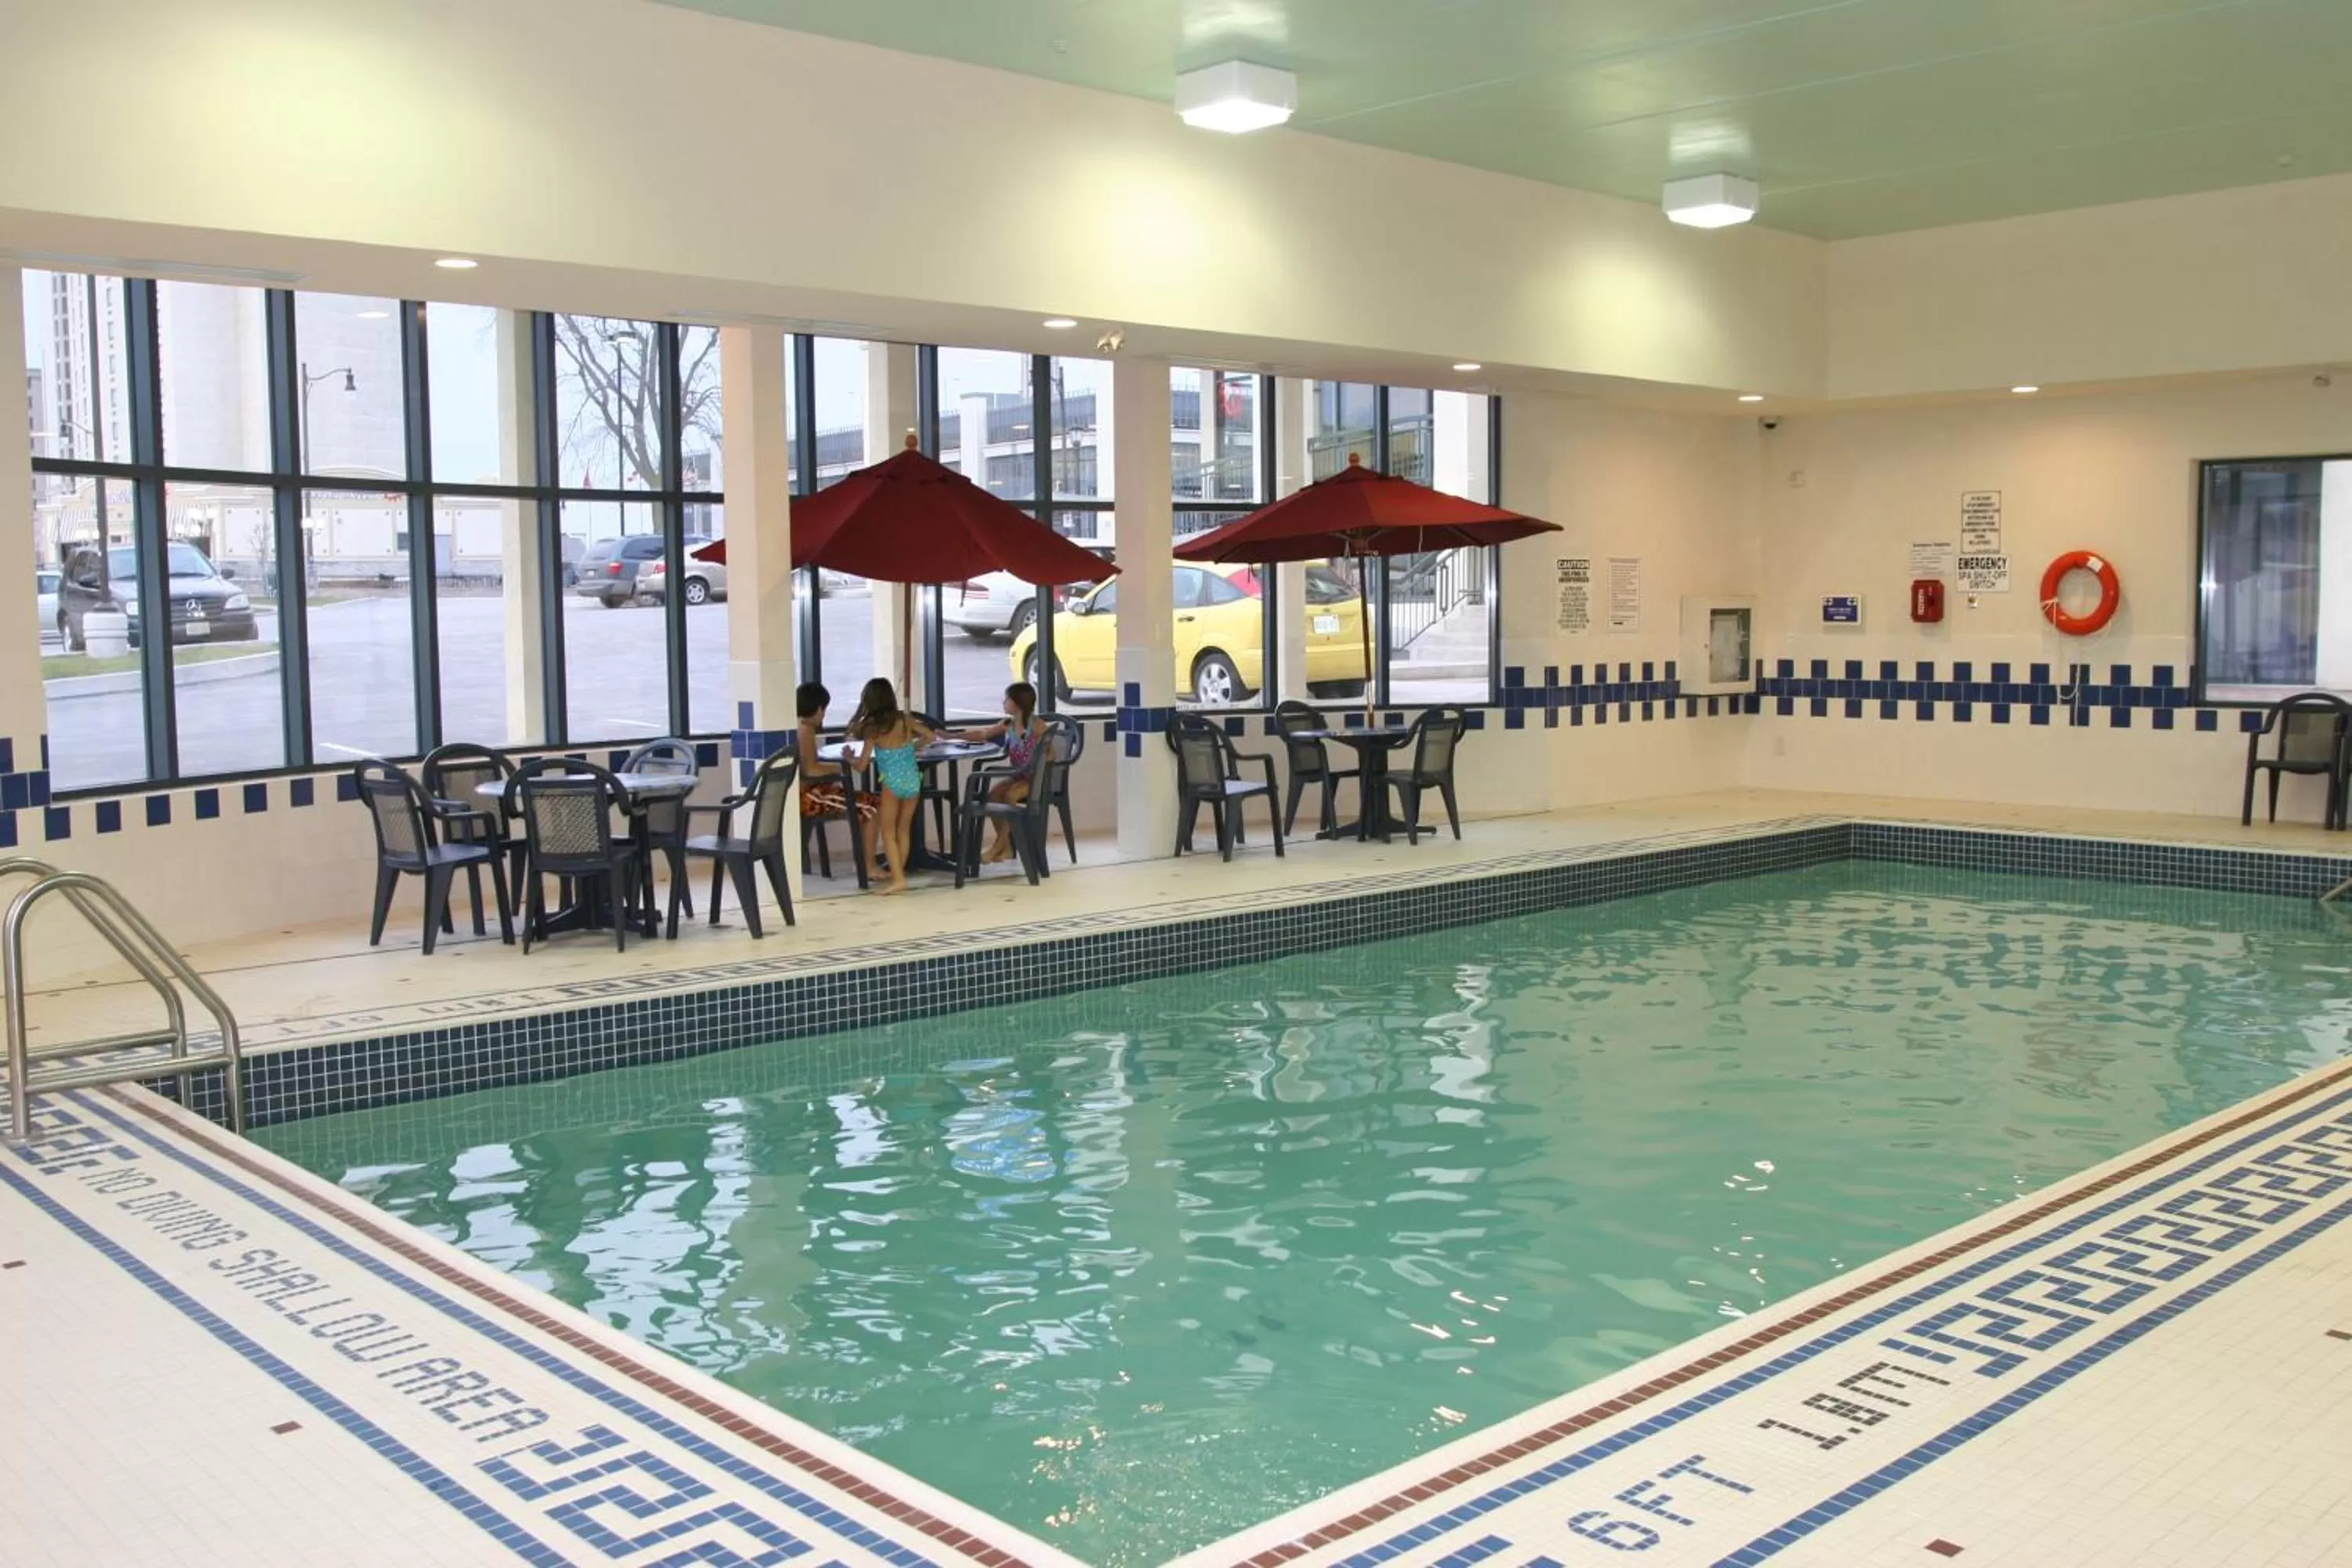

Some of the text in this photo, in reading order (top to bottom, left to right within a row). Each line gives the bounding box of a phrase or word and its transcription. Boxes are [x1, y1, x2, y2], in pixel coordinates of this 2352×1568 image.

[1958, 557, 2007, 570] EMERGENCY
[78, 1167, 550, 1443] NO DIVING SHALLOW AREA
